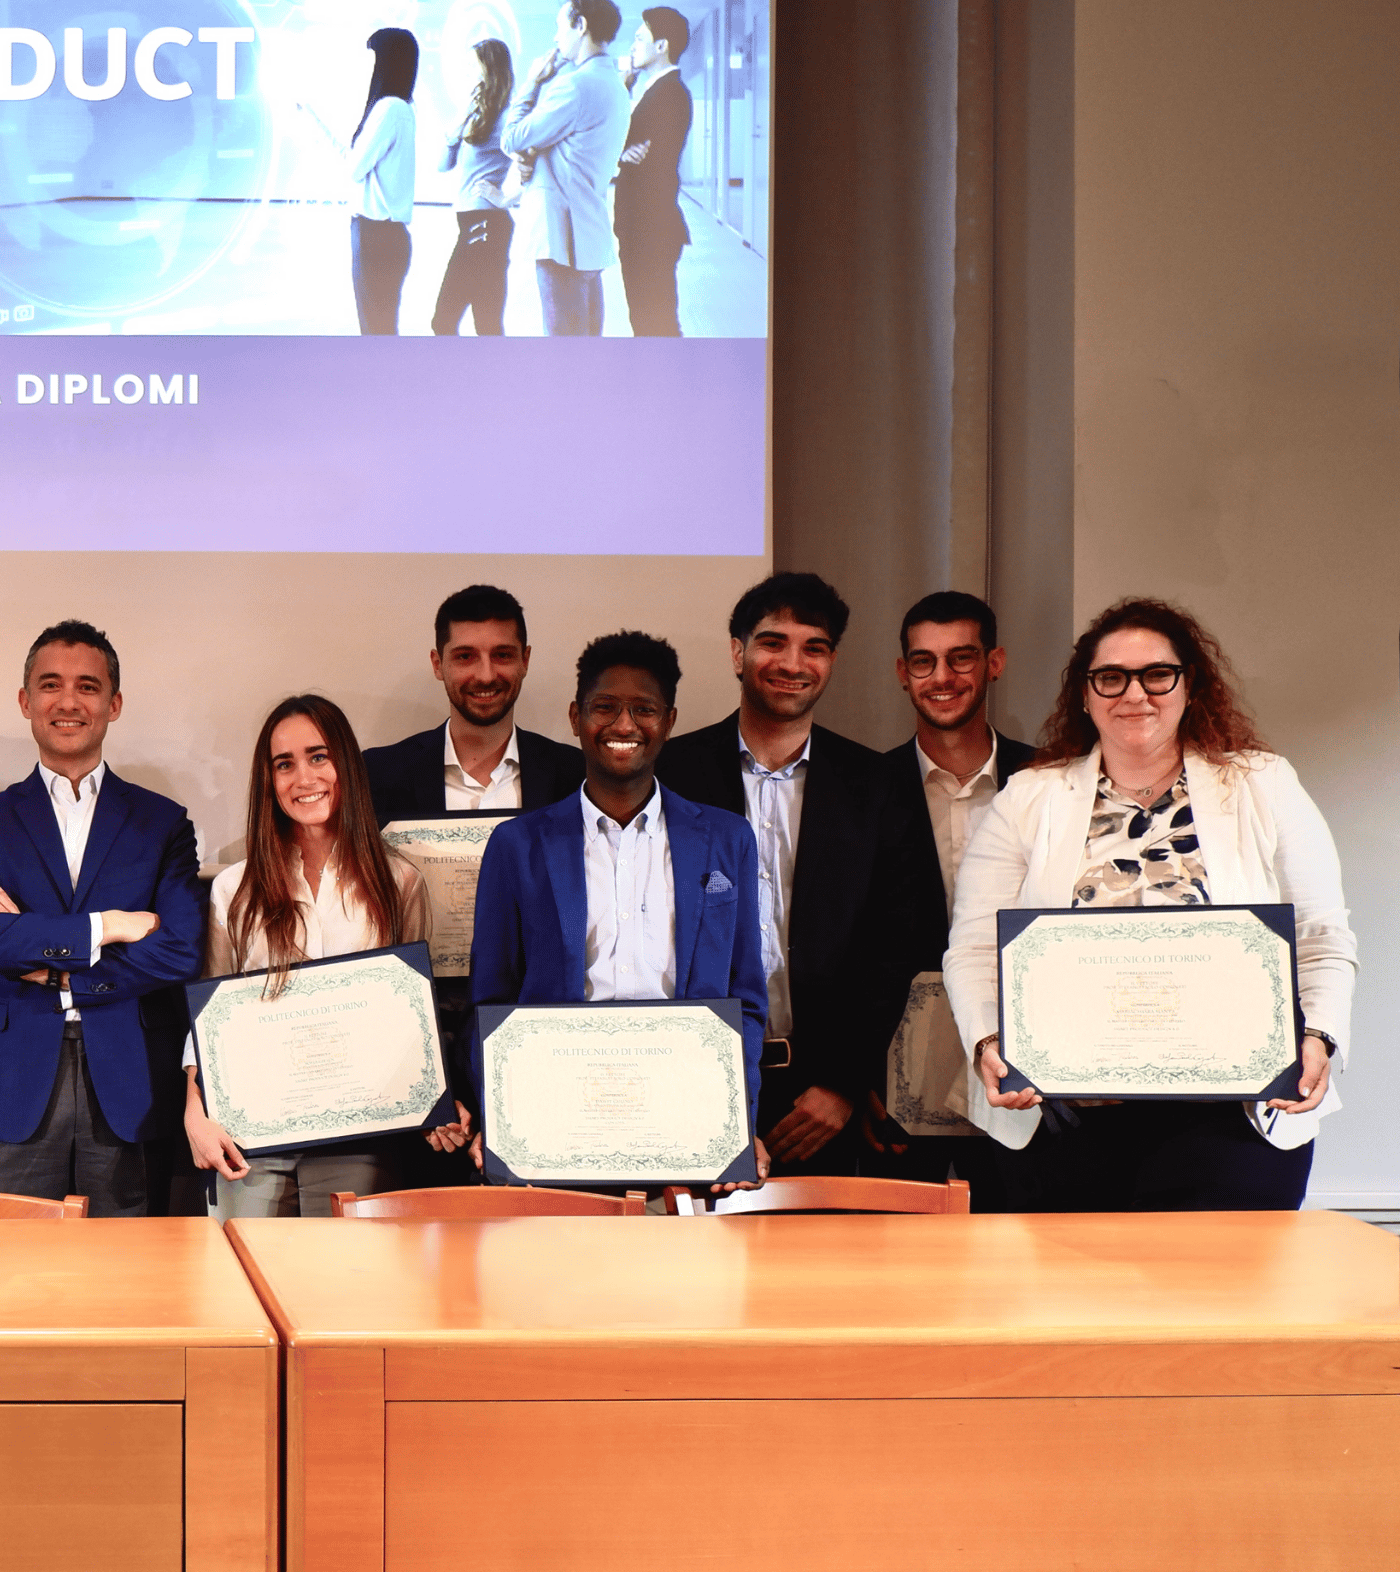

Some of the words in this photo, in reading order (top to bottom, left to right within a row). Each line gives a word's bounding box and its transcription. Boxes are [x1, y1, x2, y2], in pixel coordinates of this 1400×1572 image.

[16, 374, 199, 405] DIPLOMI
[1078, 955, 1151, 964] POLITECNICO
[1154, 955, 1165, 963] DI
[1168, 954, 1212, 962] TORINO
[258, 1009, 319, 1023] POLITECNICO
[320, 1006, 331, 1014] DI
[332, 1000, 368, 1012] TORINO
[552, 1048, 619, 1056] POLITECNICO
